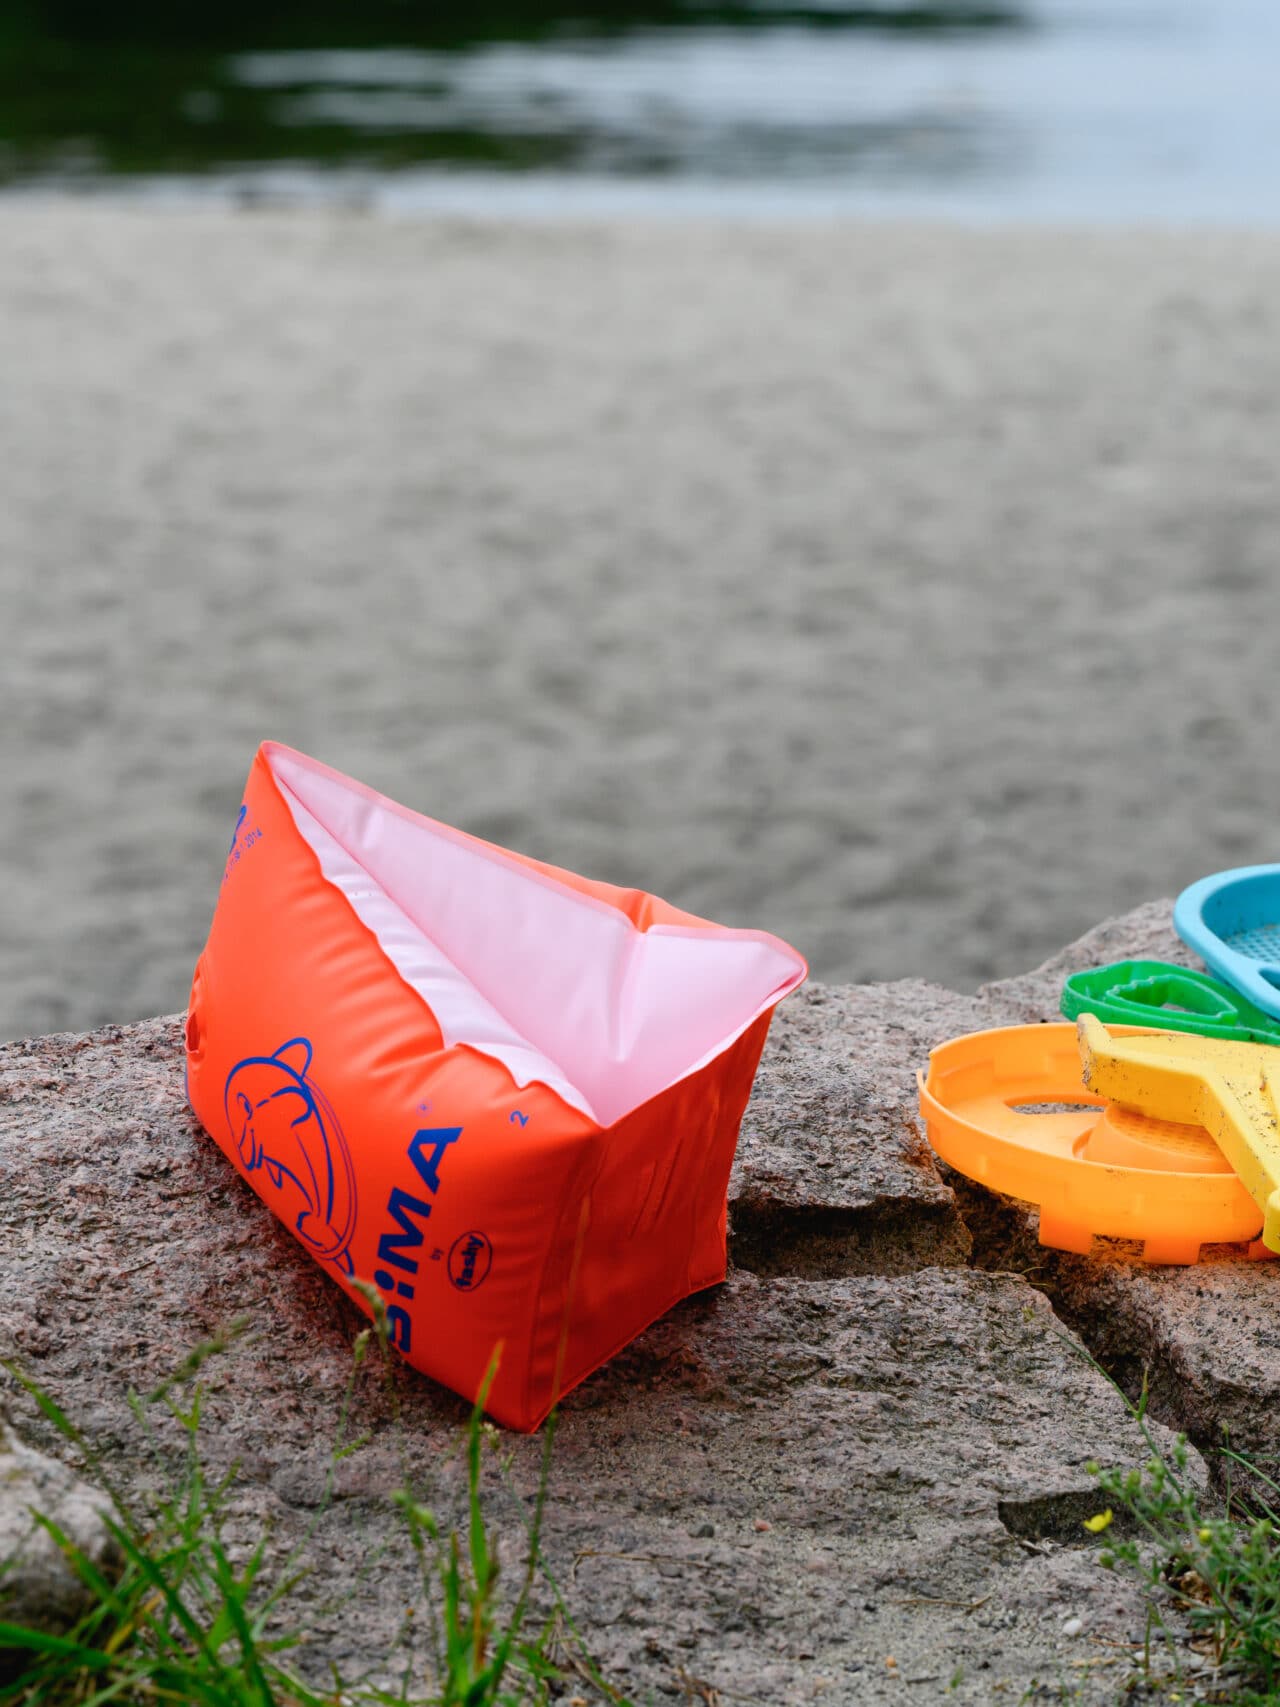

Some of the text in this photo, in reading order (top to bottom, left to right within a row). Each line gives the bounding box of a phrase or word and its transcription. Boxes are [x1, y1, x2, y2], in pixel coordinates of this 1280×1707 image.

[509, 1110, 529, 1128] 2
[430, 1247, 444, 1261] by
[455, 1234, 484, 1288] fashy
